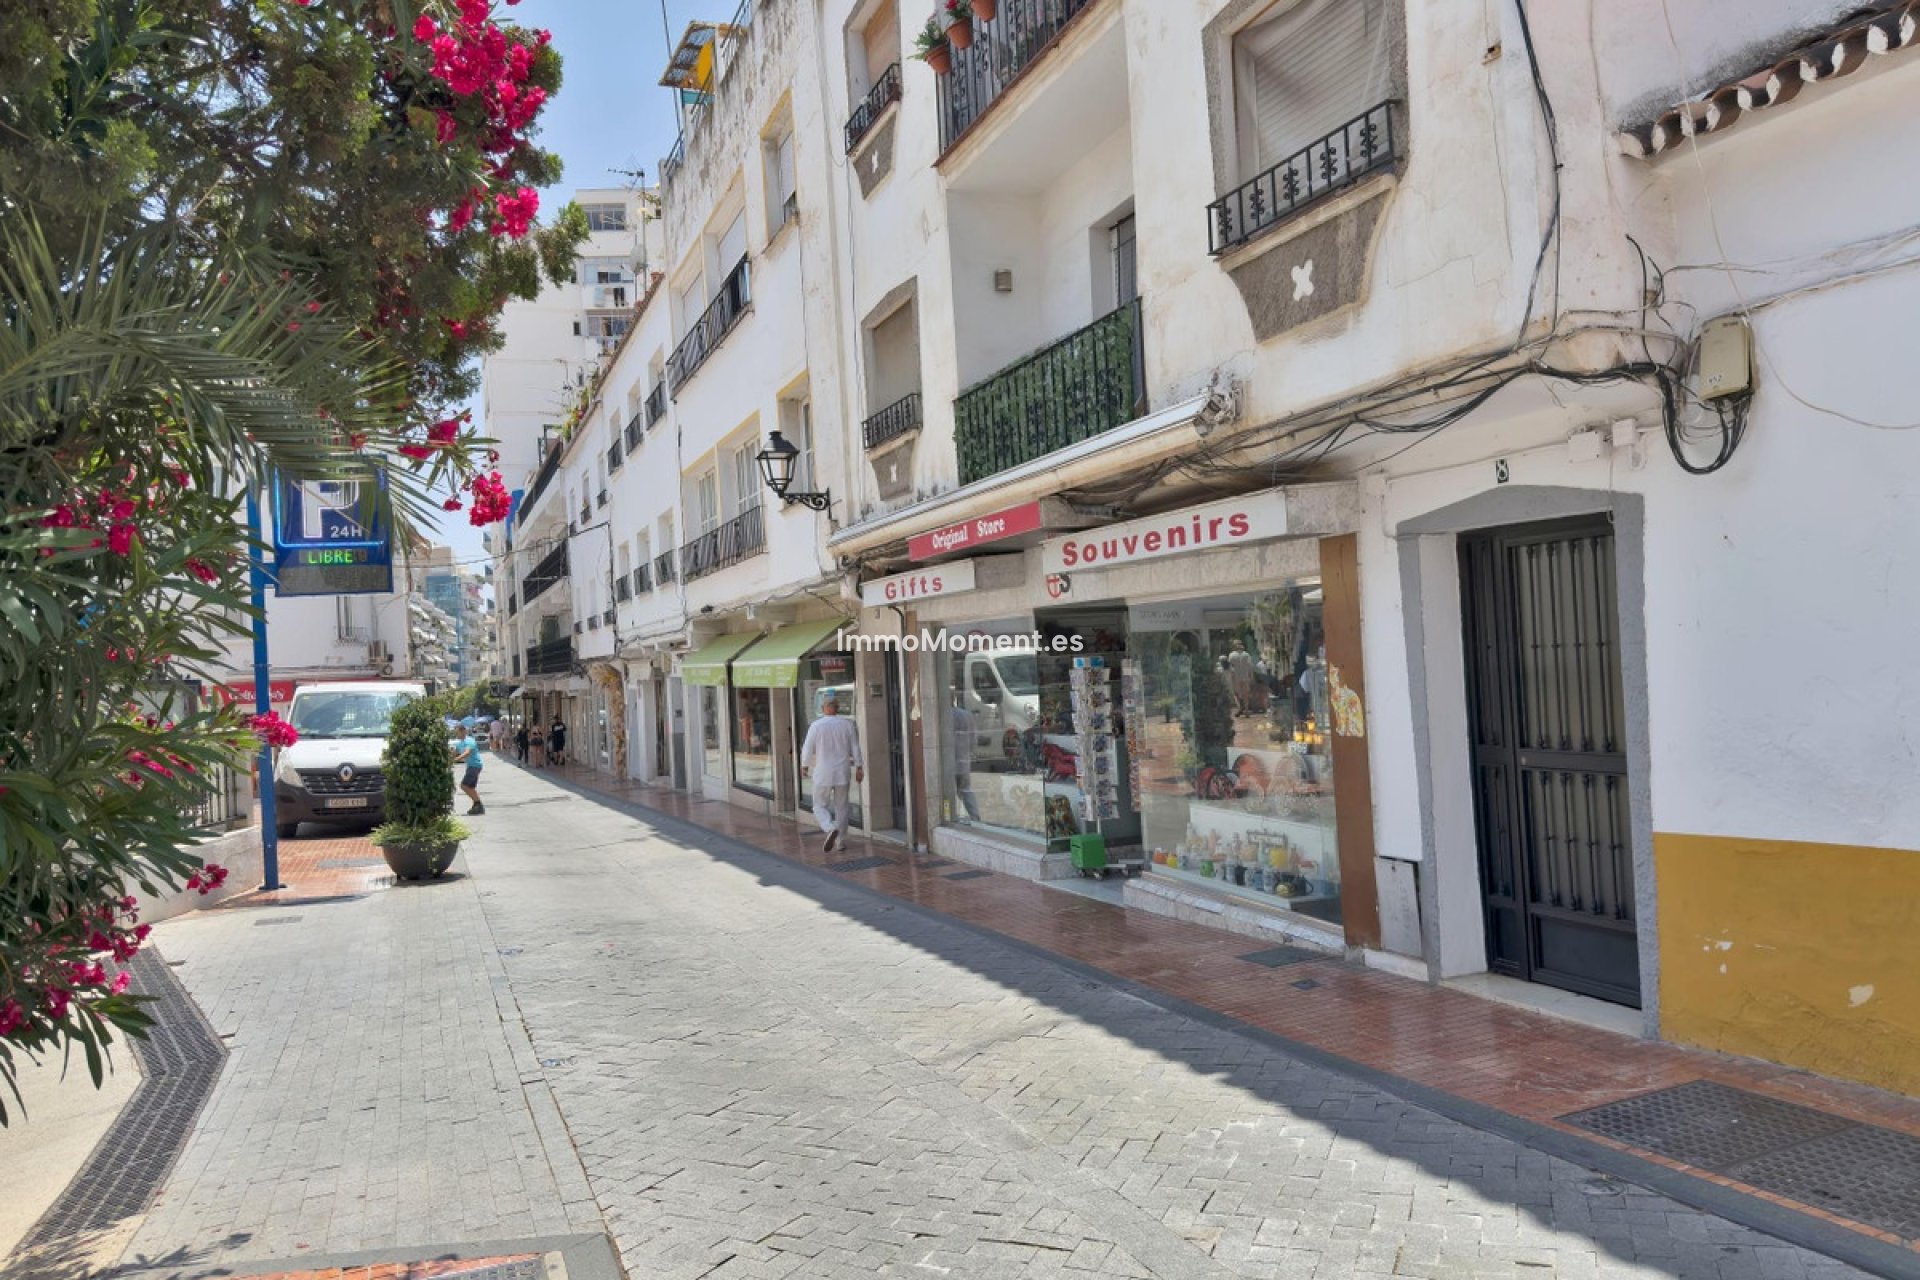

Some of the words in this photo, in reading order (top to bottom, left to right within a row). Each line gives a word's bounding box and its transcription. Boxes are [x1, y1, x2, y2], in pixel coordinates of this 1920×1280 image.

[1496, 458, 1509, 483] 8
[302, 478, 359, 538] P
[330, 525, 363, 538] 24H
[932, 525, 969, 550] Original
[977, 517, 1006, 537] Store
[1061, 512, 1249, 566] Souvenirs
[307, 548, 353, 564] LIBRE
[885, 576, 943, 601] Gifts
